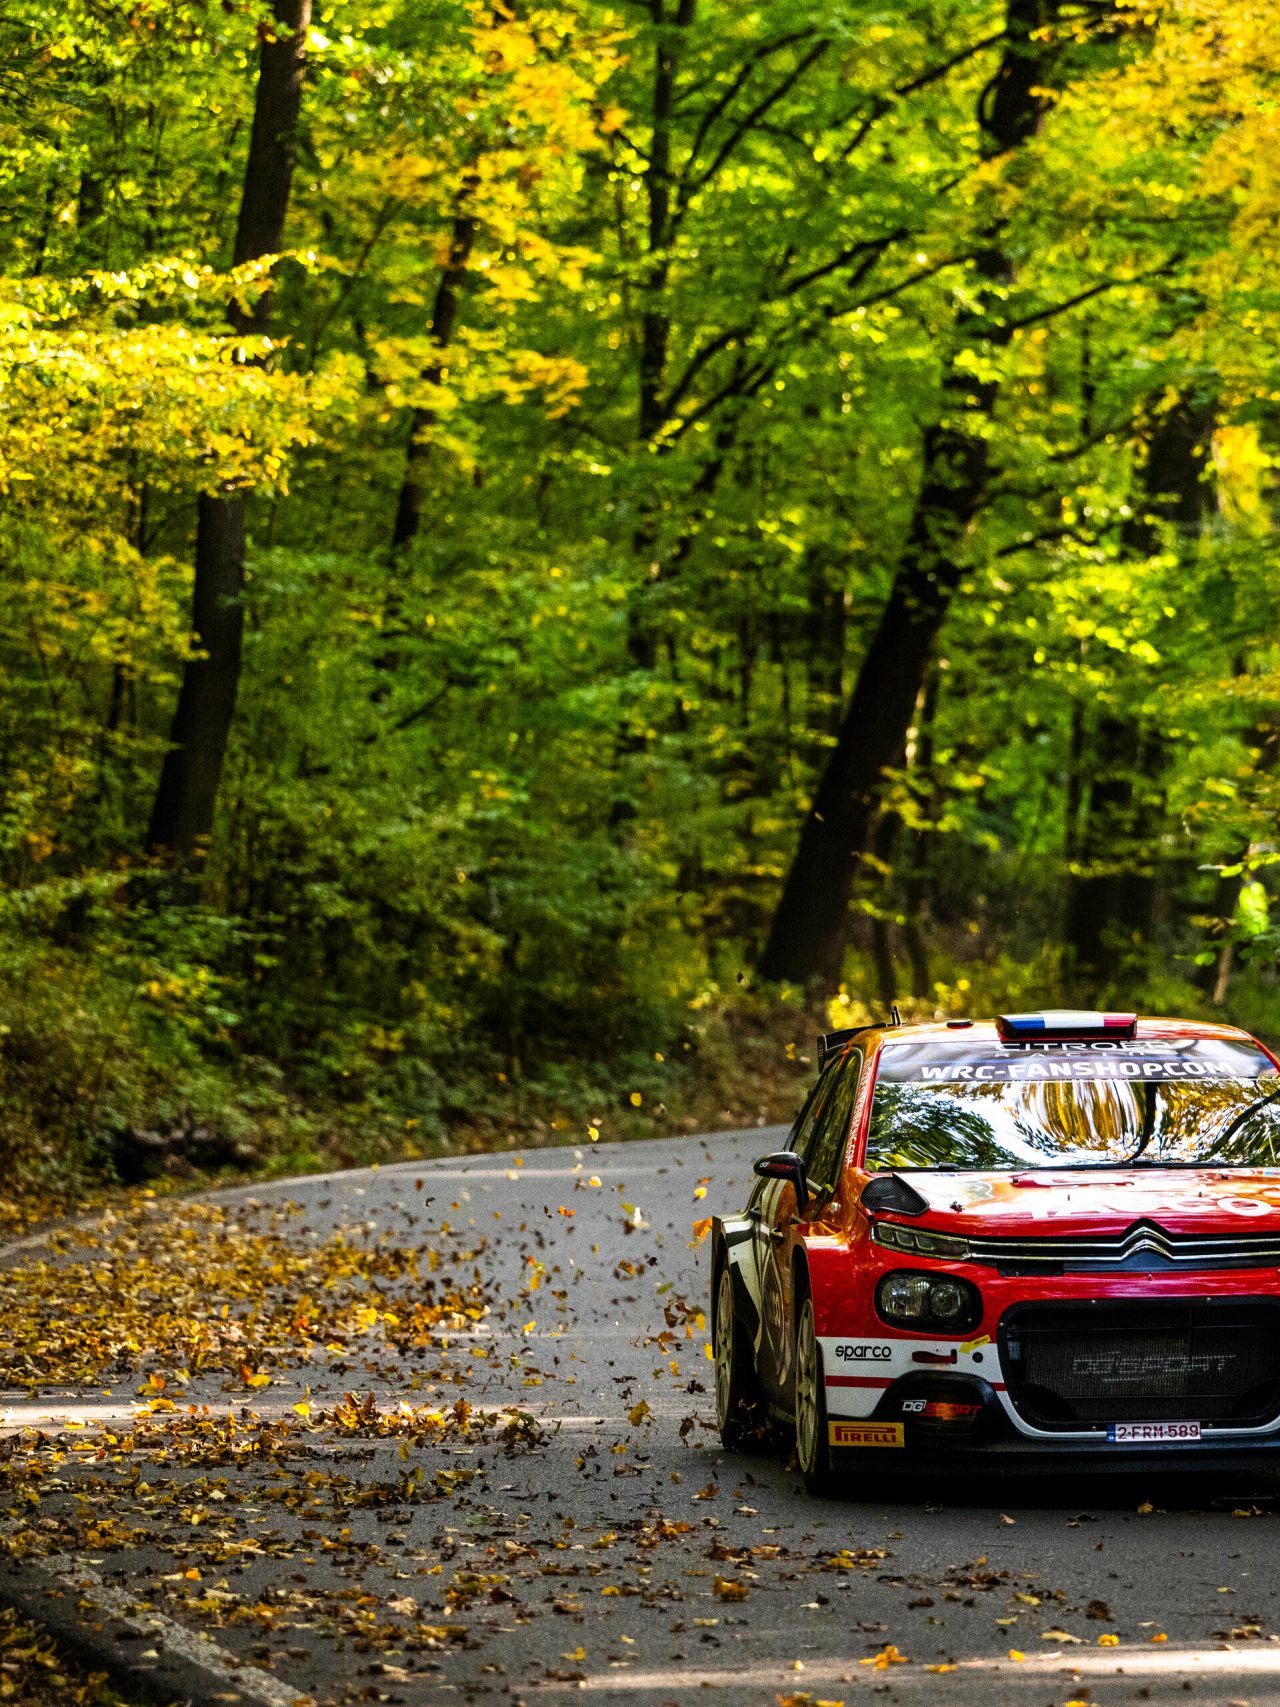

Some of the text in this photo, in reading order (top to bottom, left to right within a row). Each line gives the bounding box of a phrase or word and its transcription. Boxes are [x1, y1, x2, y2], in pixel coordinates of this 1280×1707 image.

[921, 1061, 1236, 1080] WRC-FANSHOP.COM
[835, 1345, 892, 1362] sparco
[834, 1425, 897, 1443] PIRELLI
[1117, 1424, 1199, 1440] 2-FRM-589
